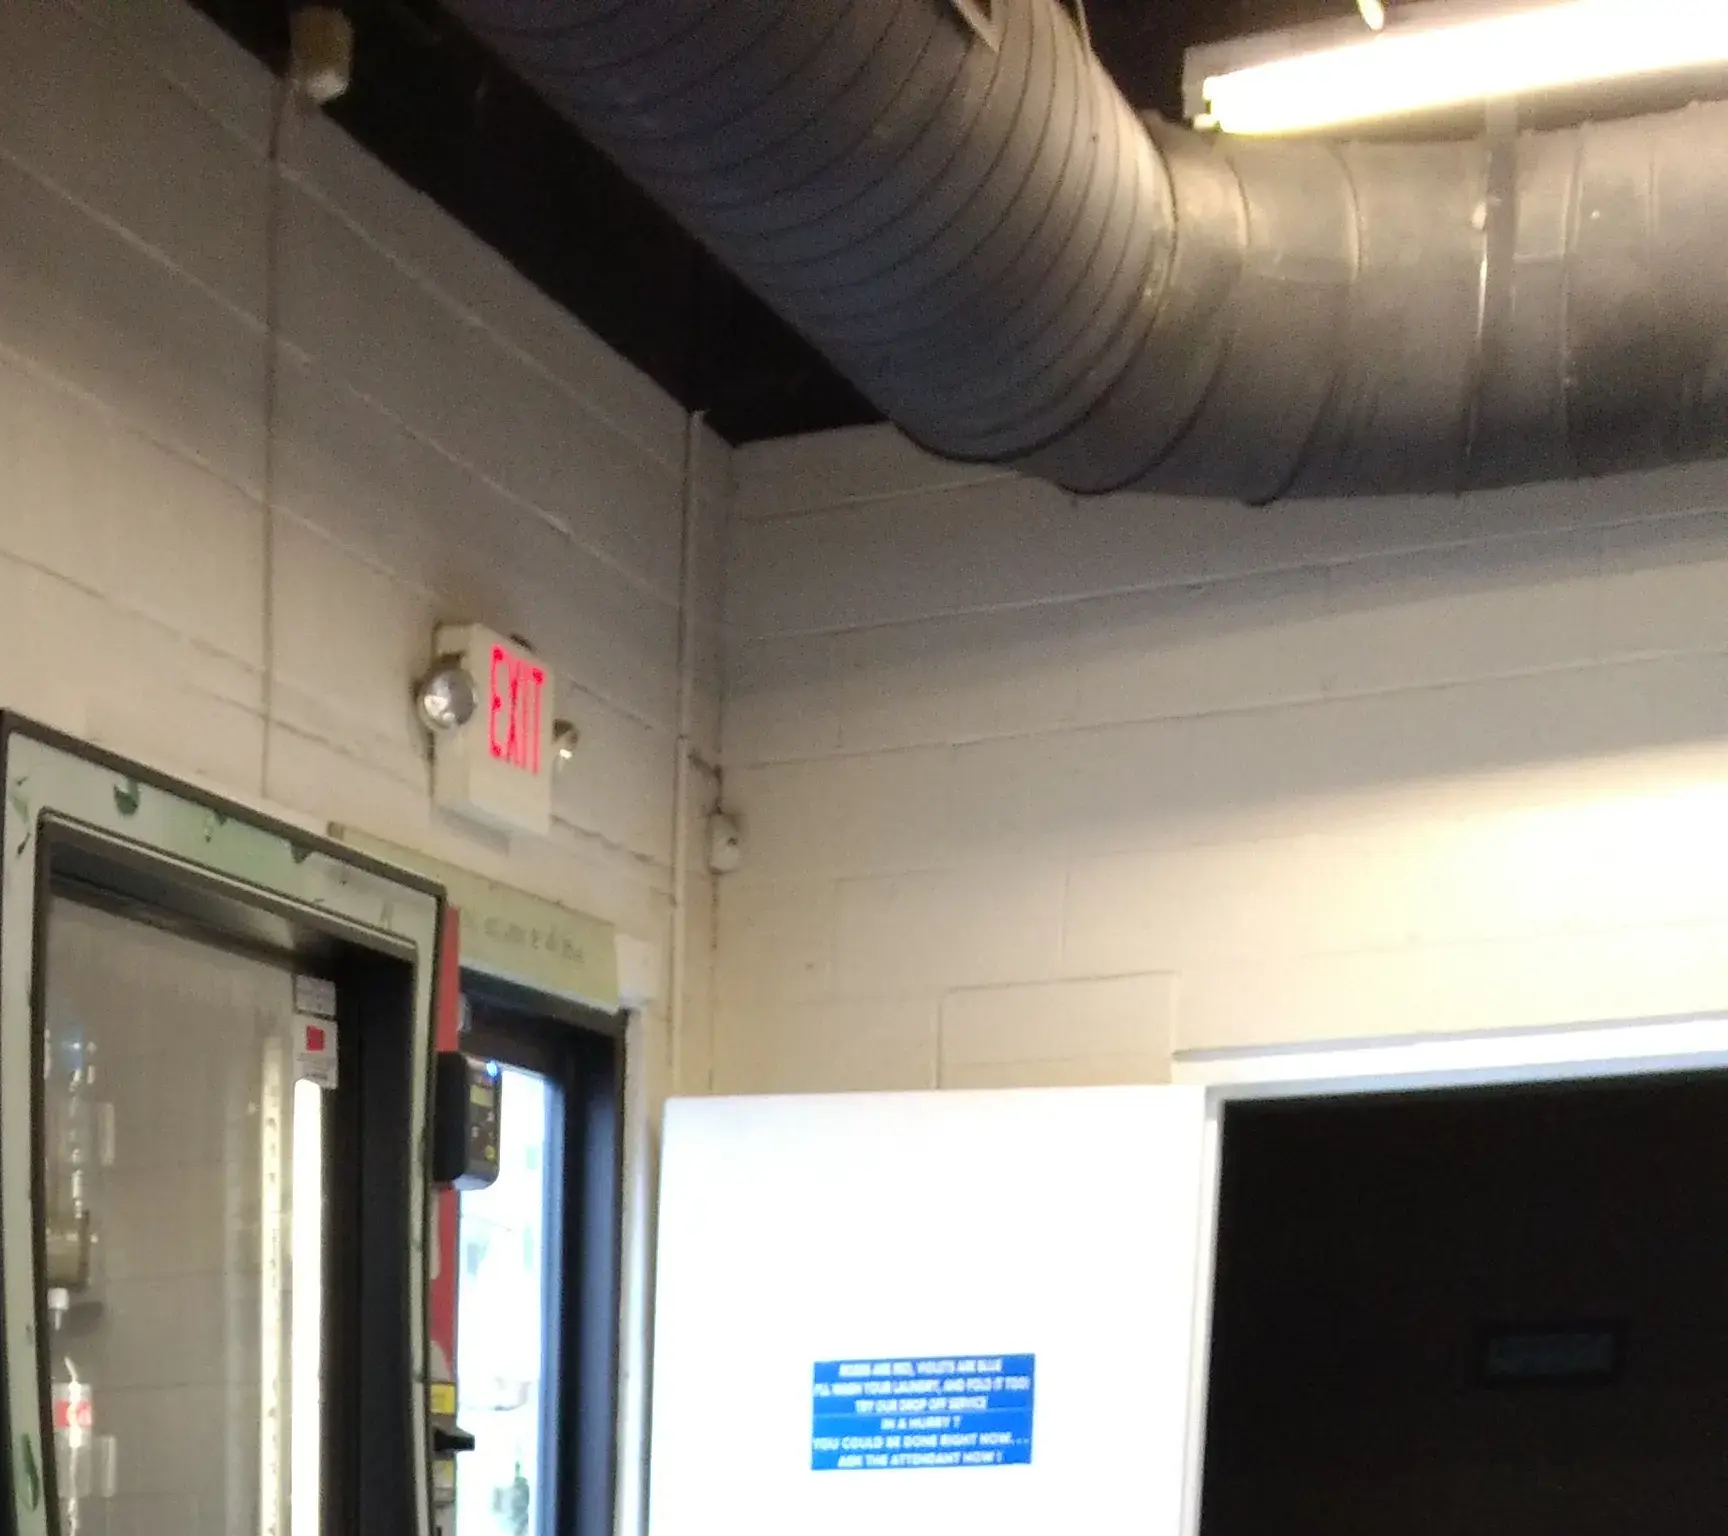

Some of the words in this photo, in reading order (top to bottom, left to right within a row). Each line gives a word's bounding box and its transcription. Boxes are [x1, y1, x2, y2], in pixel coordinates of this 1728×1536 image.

[489, 643, 545, 776] EXIT
[909, 1416, 950, 1430] HURRY
[813, 1437, 839, 1450] YOU
[842, 1436, 883, 1450] COULD
[903, 1435, 937, 1448] DONE
[940, 1433, 977, 1446] RIGHT
[866, 1454, 888, 1467] THE
[890, 1452, 961, 1466] ATTENDANT
